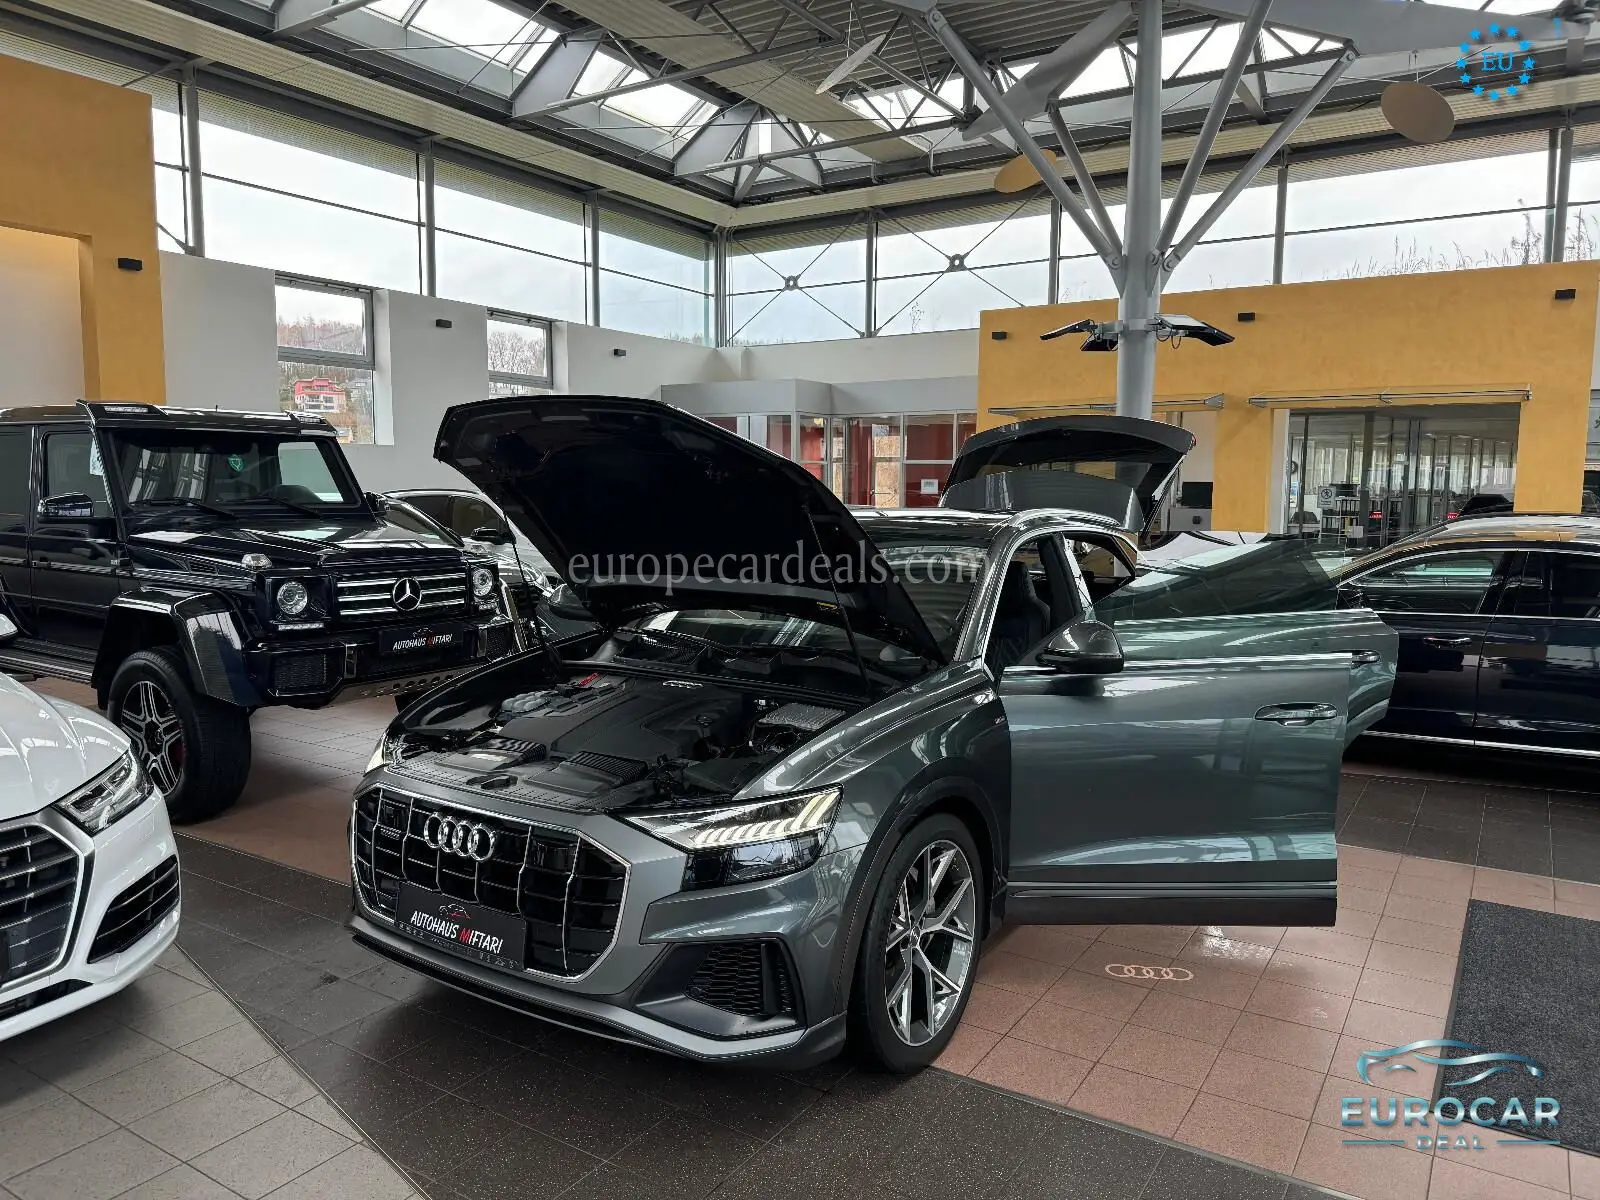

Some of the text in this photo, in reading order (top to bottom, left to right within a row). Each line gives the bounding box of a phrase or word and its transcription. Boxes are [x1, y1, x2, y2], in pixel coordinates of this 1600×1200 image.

[393, 638, 427, 650] AUTOHAUS
[410, 910, 460, 939] AUTOHAUS
[460, 927, 504, 954] MIFTARI
